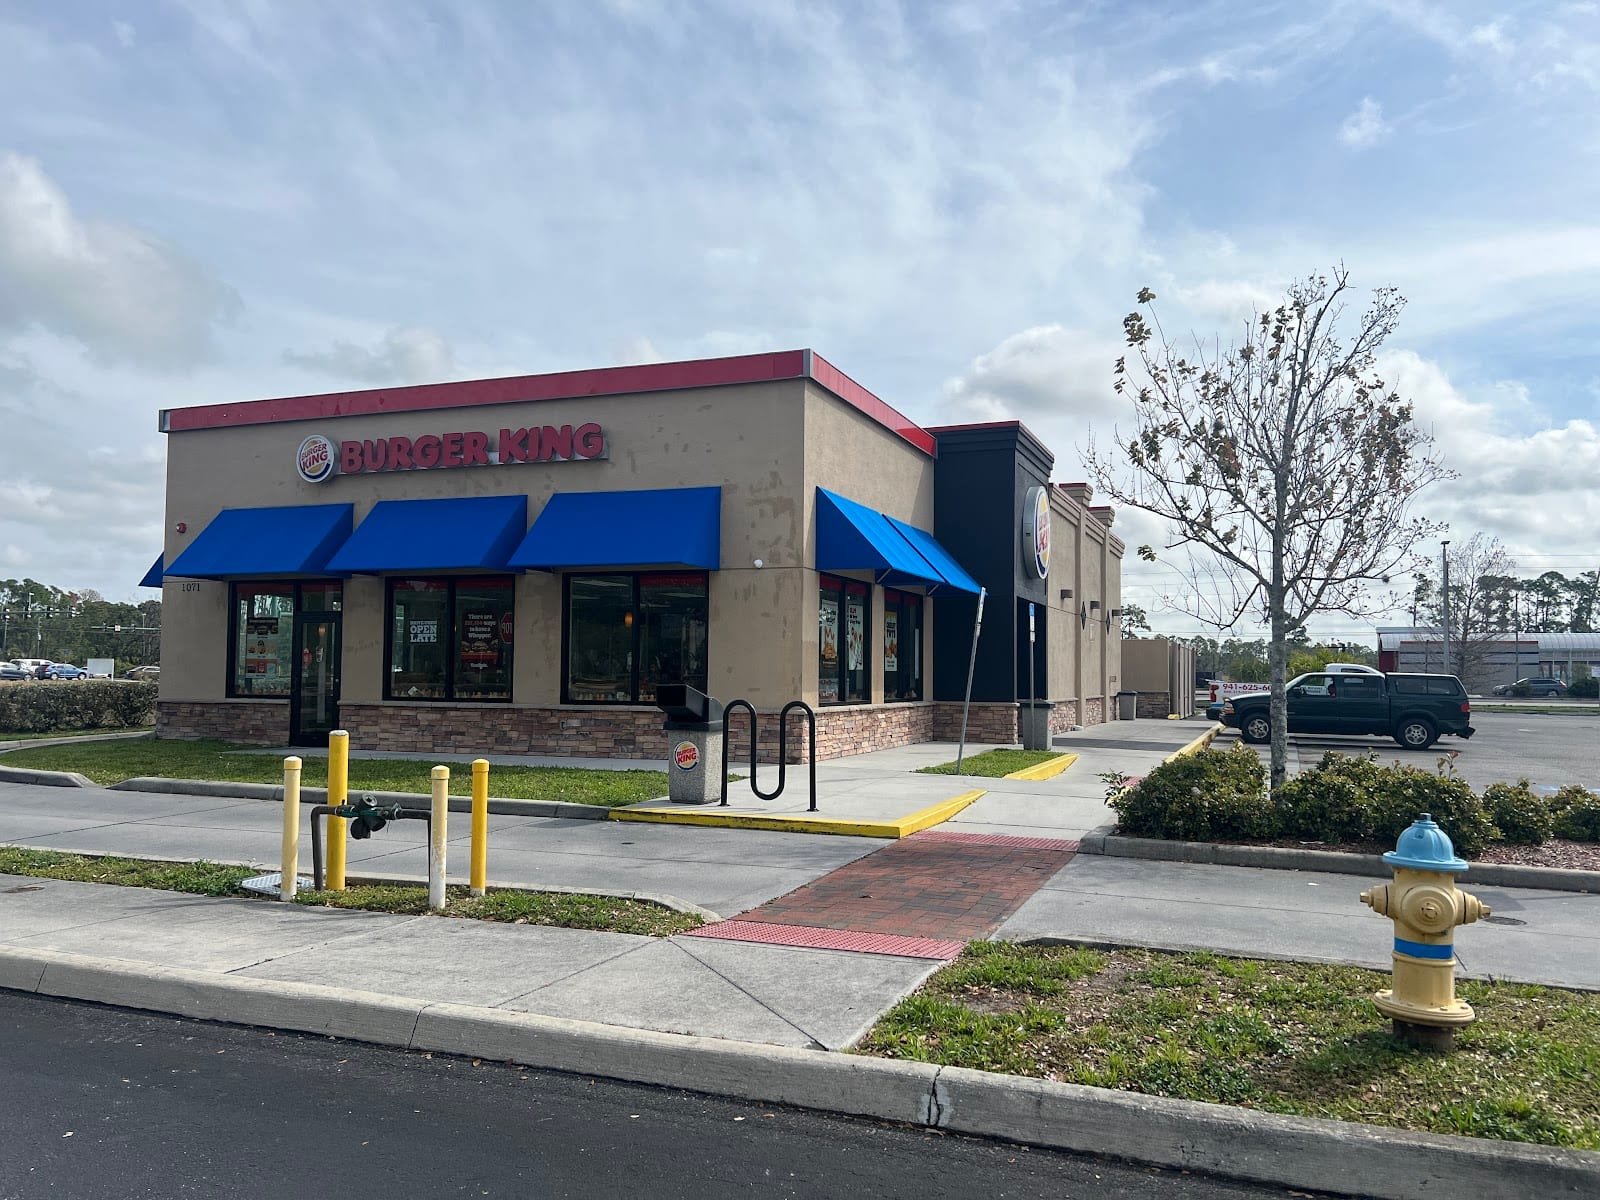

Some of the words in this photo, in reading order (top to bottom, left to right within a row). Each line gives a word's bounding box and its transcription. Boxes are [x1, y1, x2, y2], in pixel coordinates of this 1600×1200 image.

[301, 443, 327, 461] BURGER
[340, 431, 490, 474] BURGER
[498, 422, 604, 464] KING
[302, 450, 328, 472] KING
[181, 583, 200, 592] 1071
[410, 625, 437, 634] OPEN
[410, 634, 437, 642] LATE
[1222, 683, 1273, 691] 941-625-60
[677, 747, 696, 757] BURGER
[677, 753, 697, 764] KING
